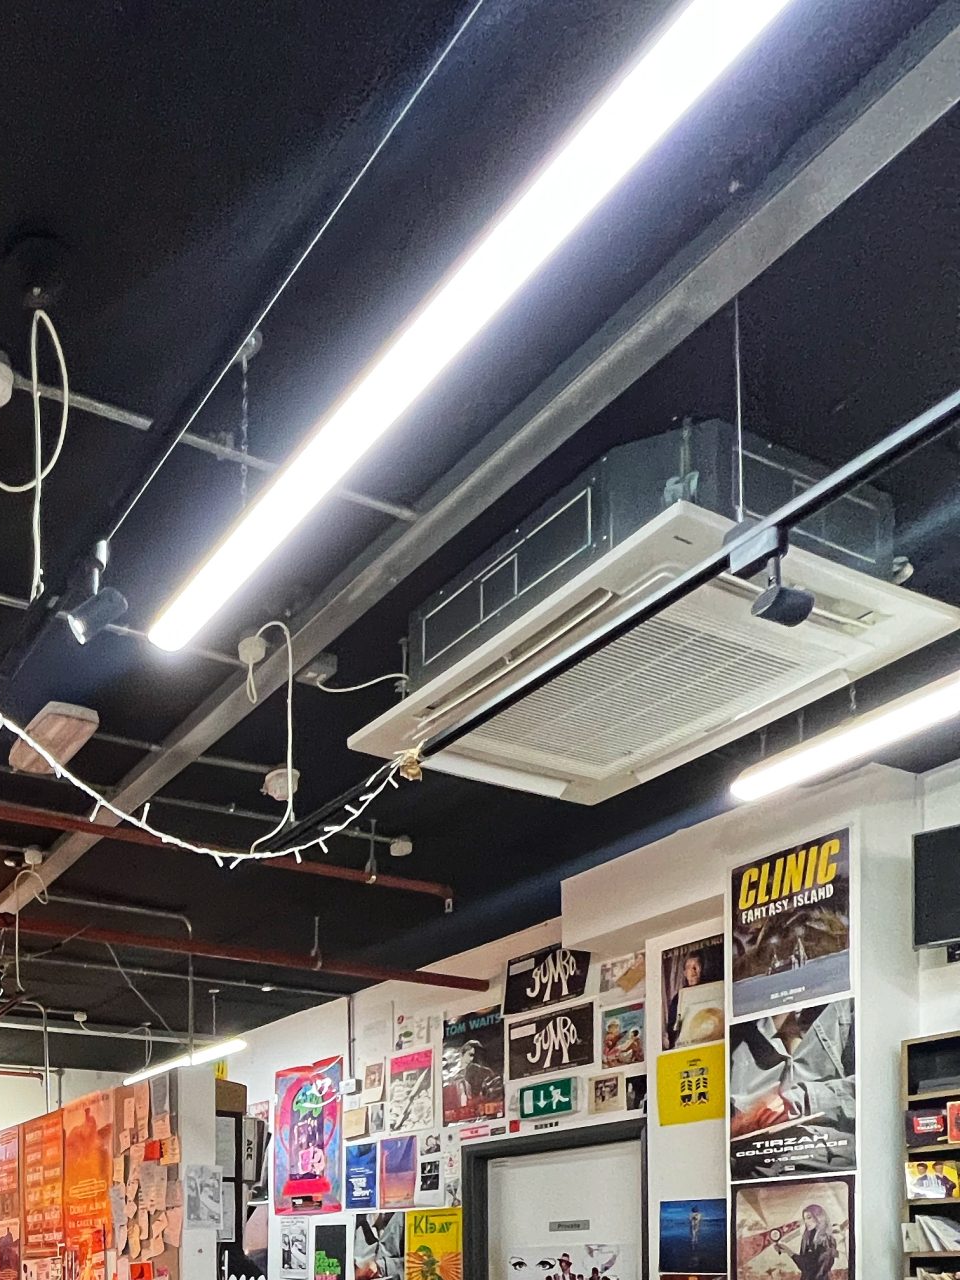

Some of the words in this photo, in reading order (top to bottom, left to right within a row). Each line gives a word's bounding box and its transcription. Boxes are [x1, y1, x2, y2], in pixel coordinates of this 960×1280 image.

[739, 839, 840, 910] CLINIC
[742, 898, 789, 925] FANTASY
[793, 883, 834, 908] ISLAND
[526, 948, 577, 1003] JUMBO
[446, 1023, 466, 1037] TOM
[469, 1013, 502, 1031] WAITS
[526, 1016, 577, 1069] JUMBO
[736, 1140, 848, 1157] COLOURGRADE
[752, 1134, 829, 1149] TIRZAH
[558, 1222, 581, 1230] Private
